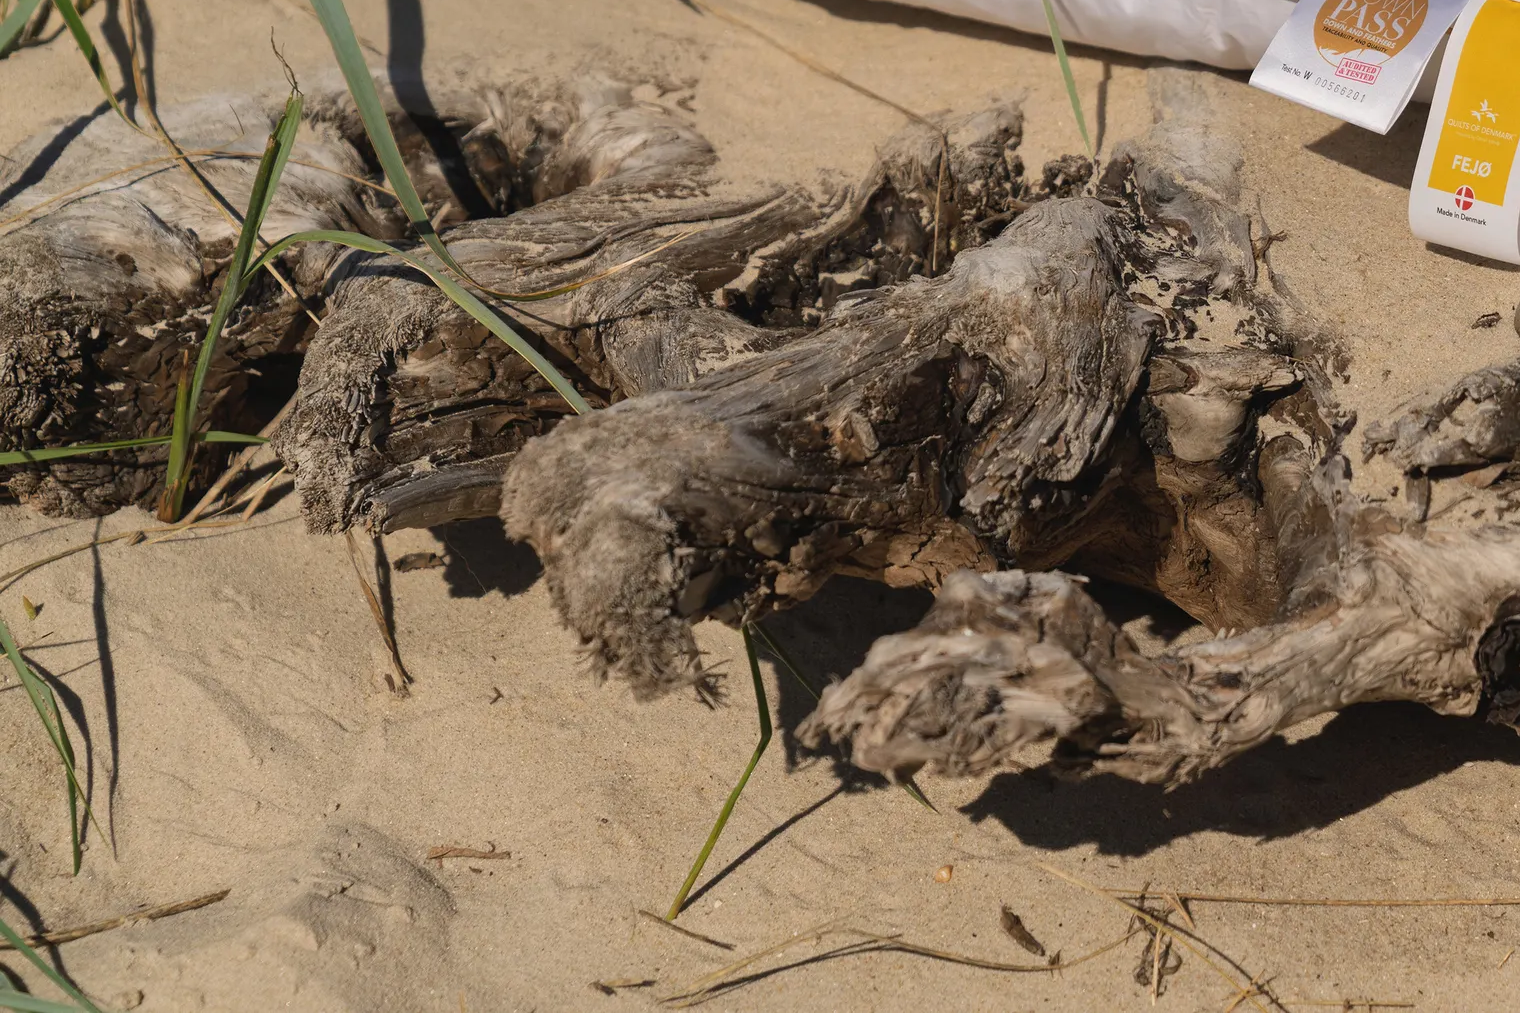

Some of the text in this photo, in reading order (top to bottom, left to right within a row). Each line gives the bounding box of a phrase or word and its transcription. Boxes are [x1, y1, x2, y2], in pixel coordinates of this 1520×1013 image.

[1322, 18, 1397, 49] DOWN AND FEATHERS
[1322, 26, 1389, 54] TRACEABILITY AND QUALITY
[1342, 60, 1377, 74] AUDITED
[1343, 69, 1375, 82] TESTED
[1281, 63, 1366, 103] Test No. W 00566201
[1448, 119, 1469, 130] QUILTS
[1451, 154, 1492, 178] FEJØ
[1436, 207, 1453, 218] Made
[1460, 213, 1487, 226] Denmark
